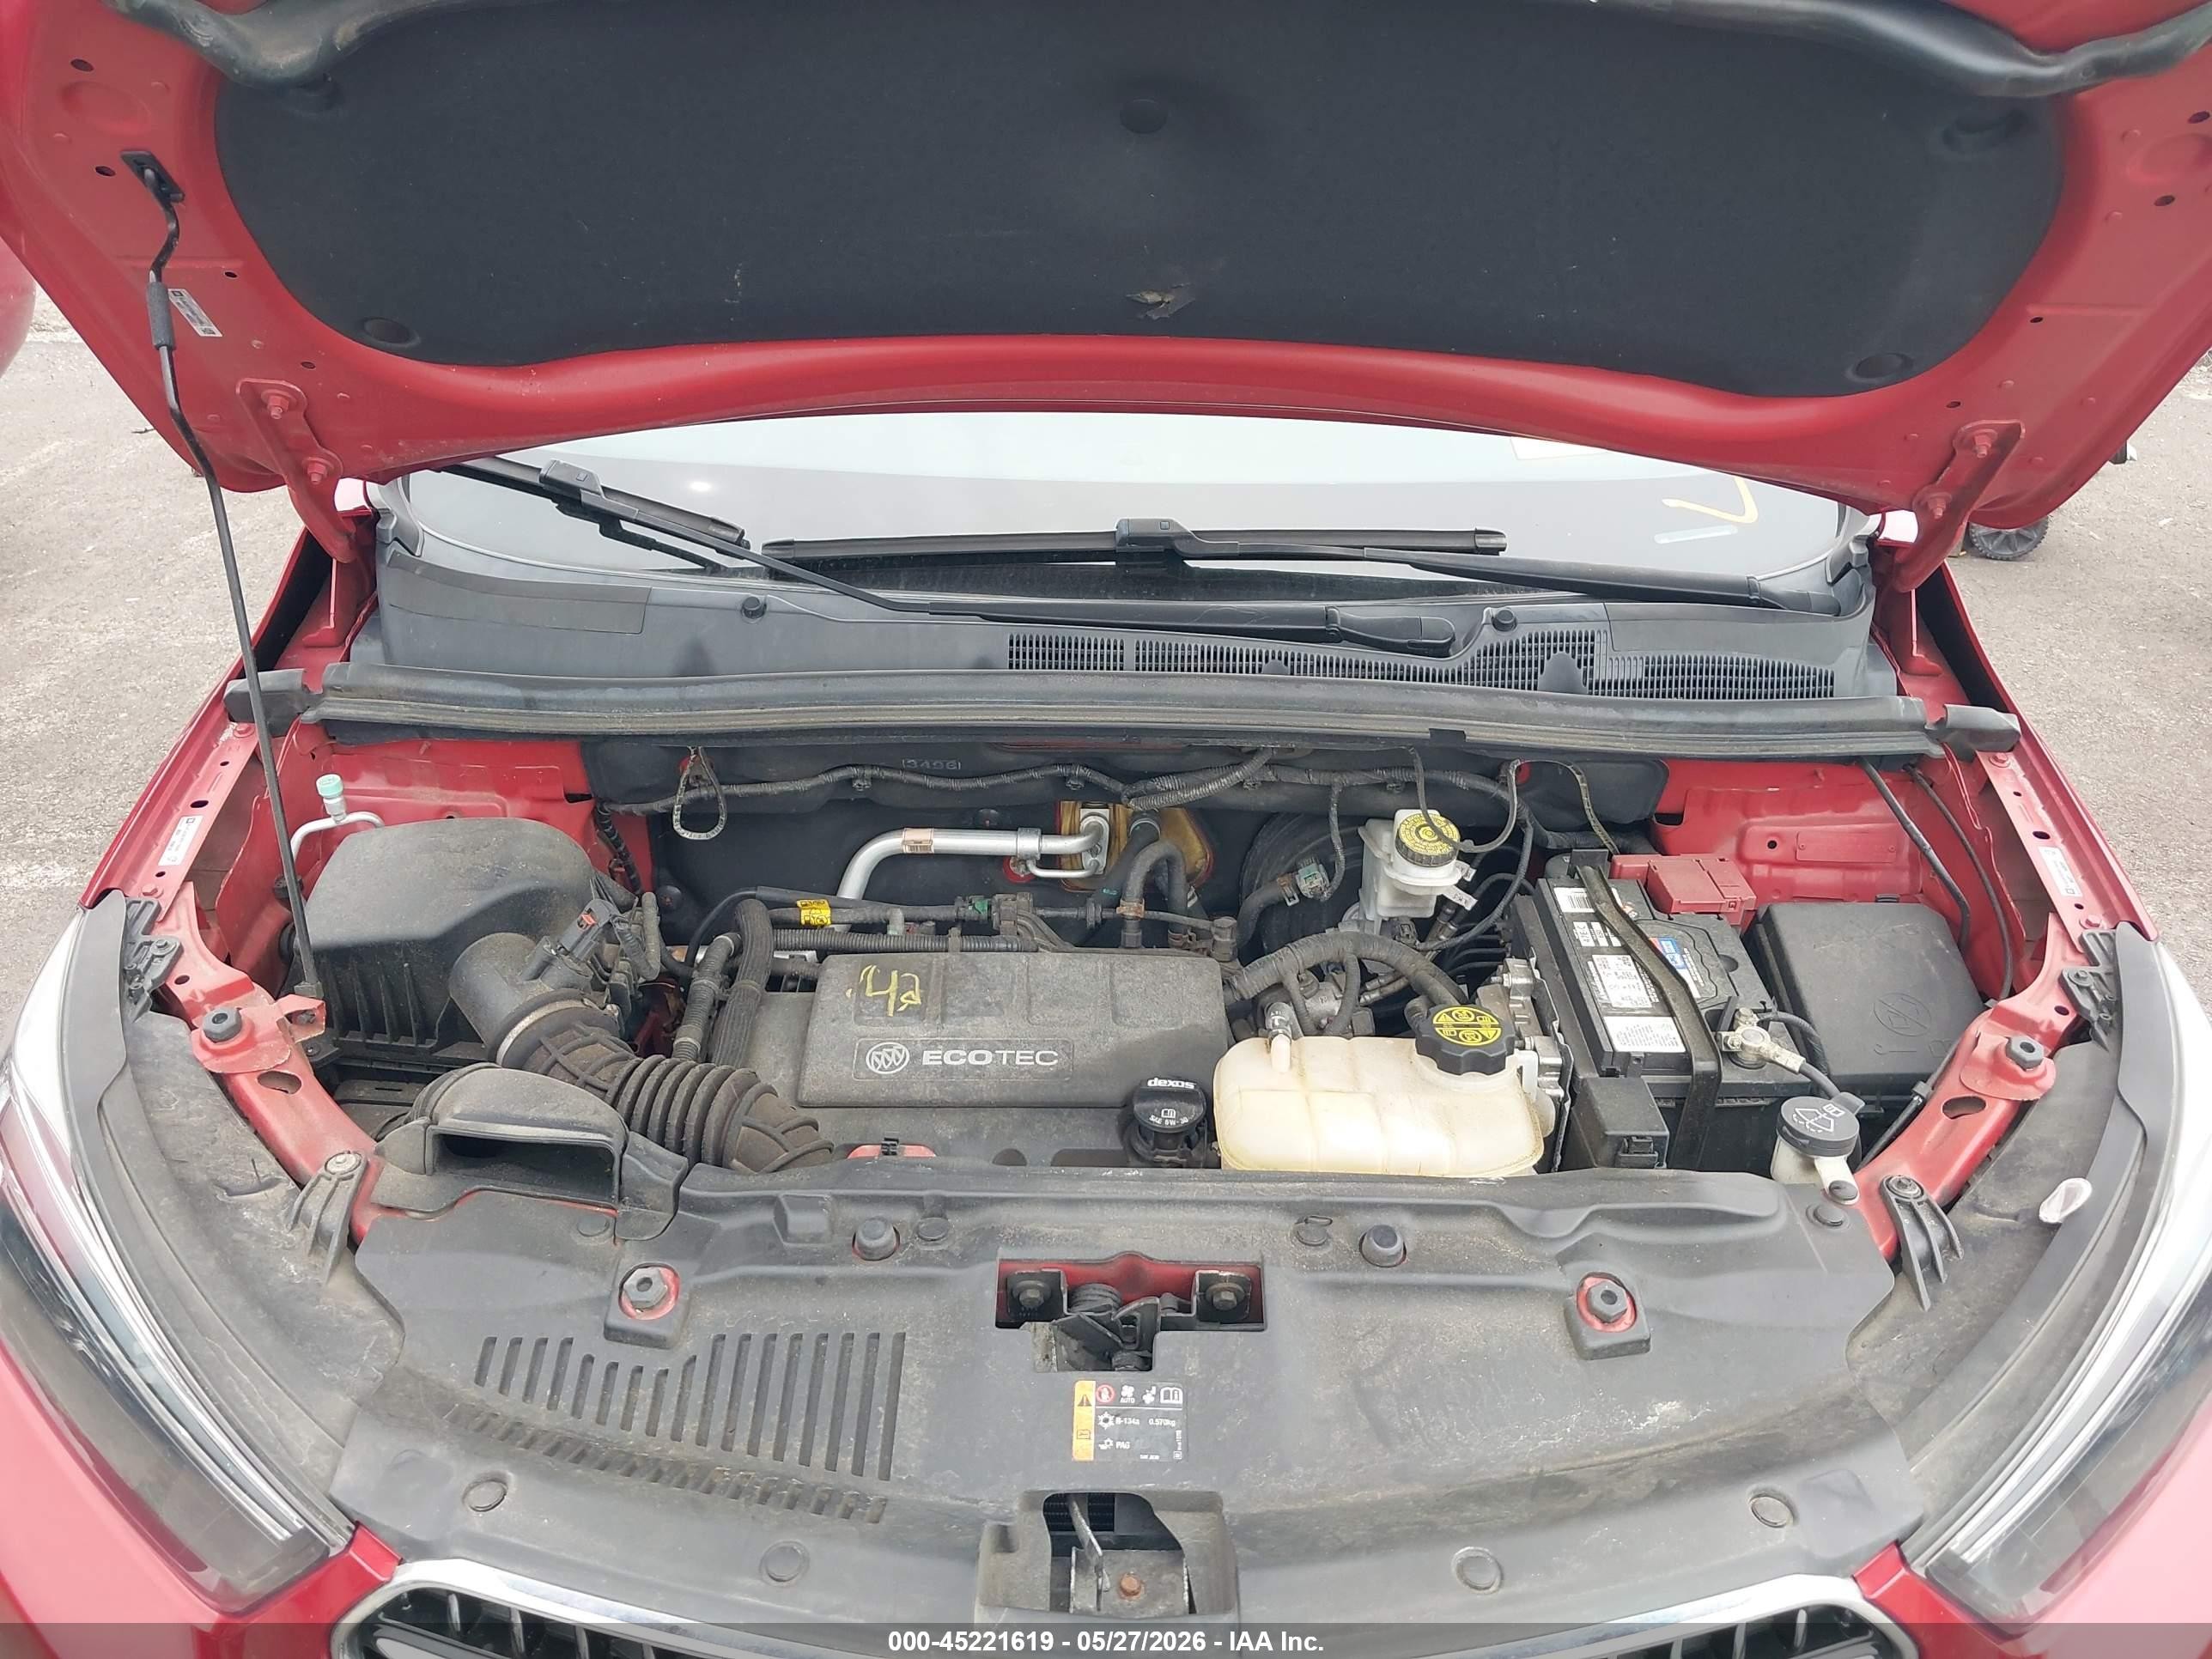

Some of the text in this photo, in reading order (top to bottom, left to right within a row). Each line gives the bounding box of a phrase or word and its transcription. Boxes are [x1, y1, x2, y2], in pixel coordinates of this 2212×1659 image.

[921, 1049, 1059, 1066] ECOTEC
[1147, 1077, 1197, 1090] dexos
[1149, 1115, 1163, 1124] SAE
[1115, 1441, 1131, 1449] PAG
